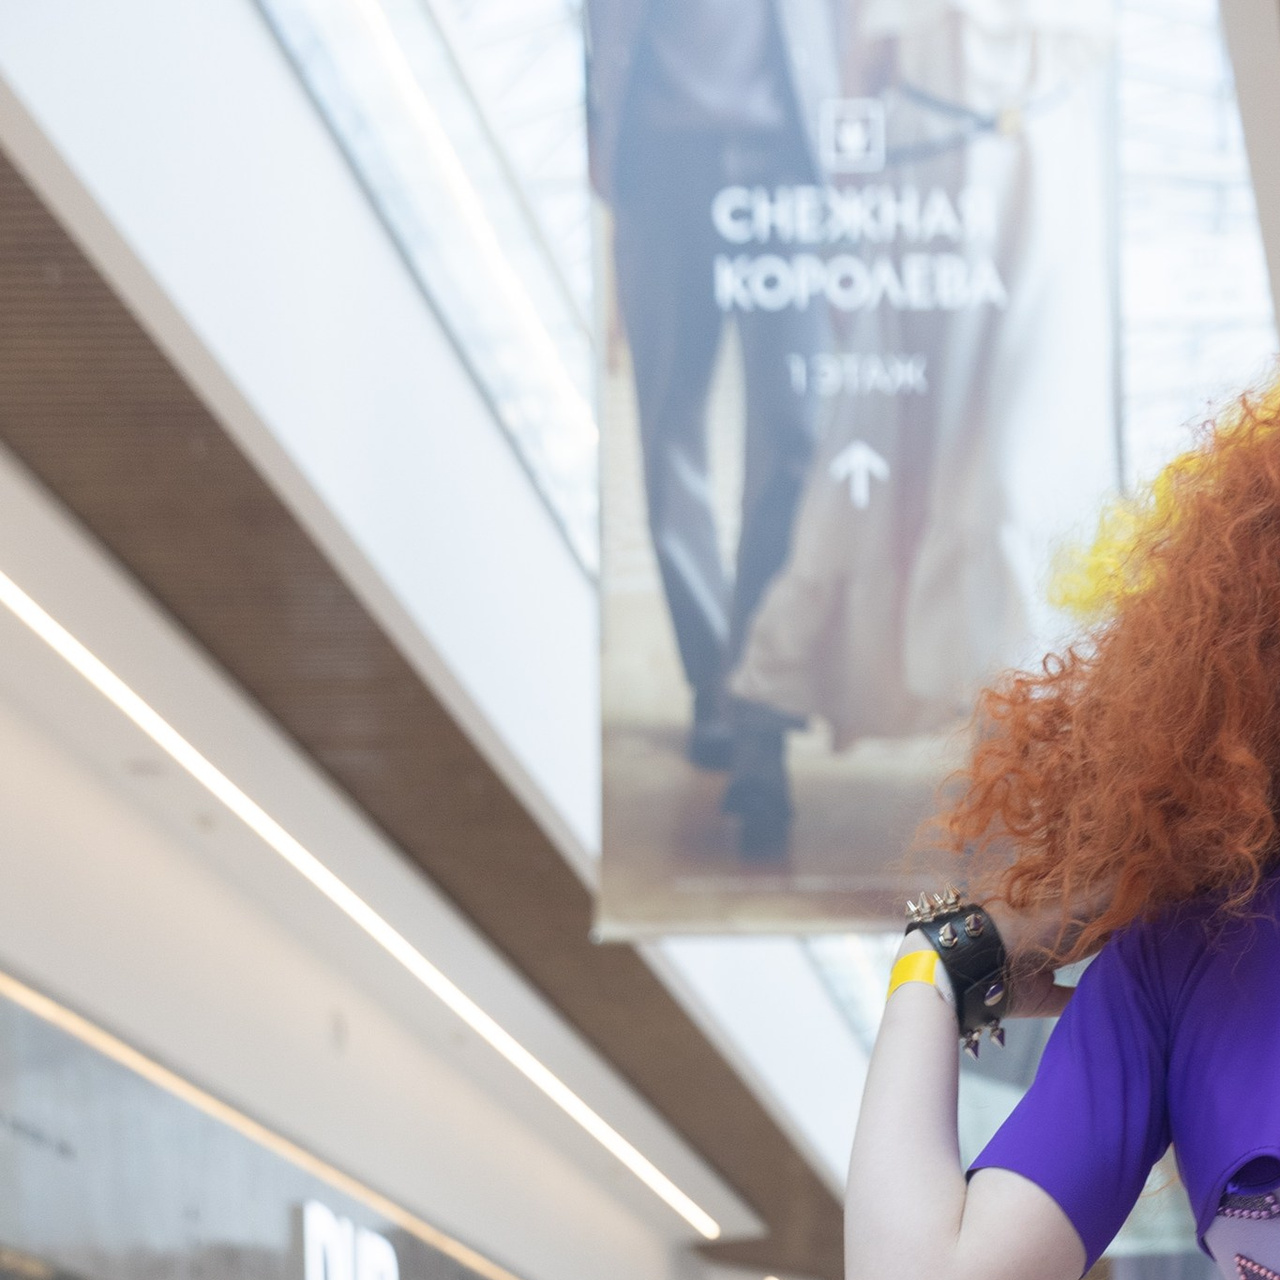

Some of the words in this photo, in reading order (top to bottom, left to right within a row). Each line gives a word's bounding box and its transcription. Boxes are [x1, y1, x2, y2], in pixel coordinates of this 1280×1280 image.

[714, 254, 1008, 311] КОРОЛЕВА
[787, 353, 808, 394] 1
[816, 354, 928, 394] ЭТАЖ
